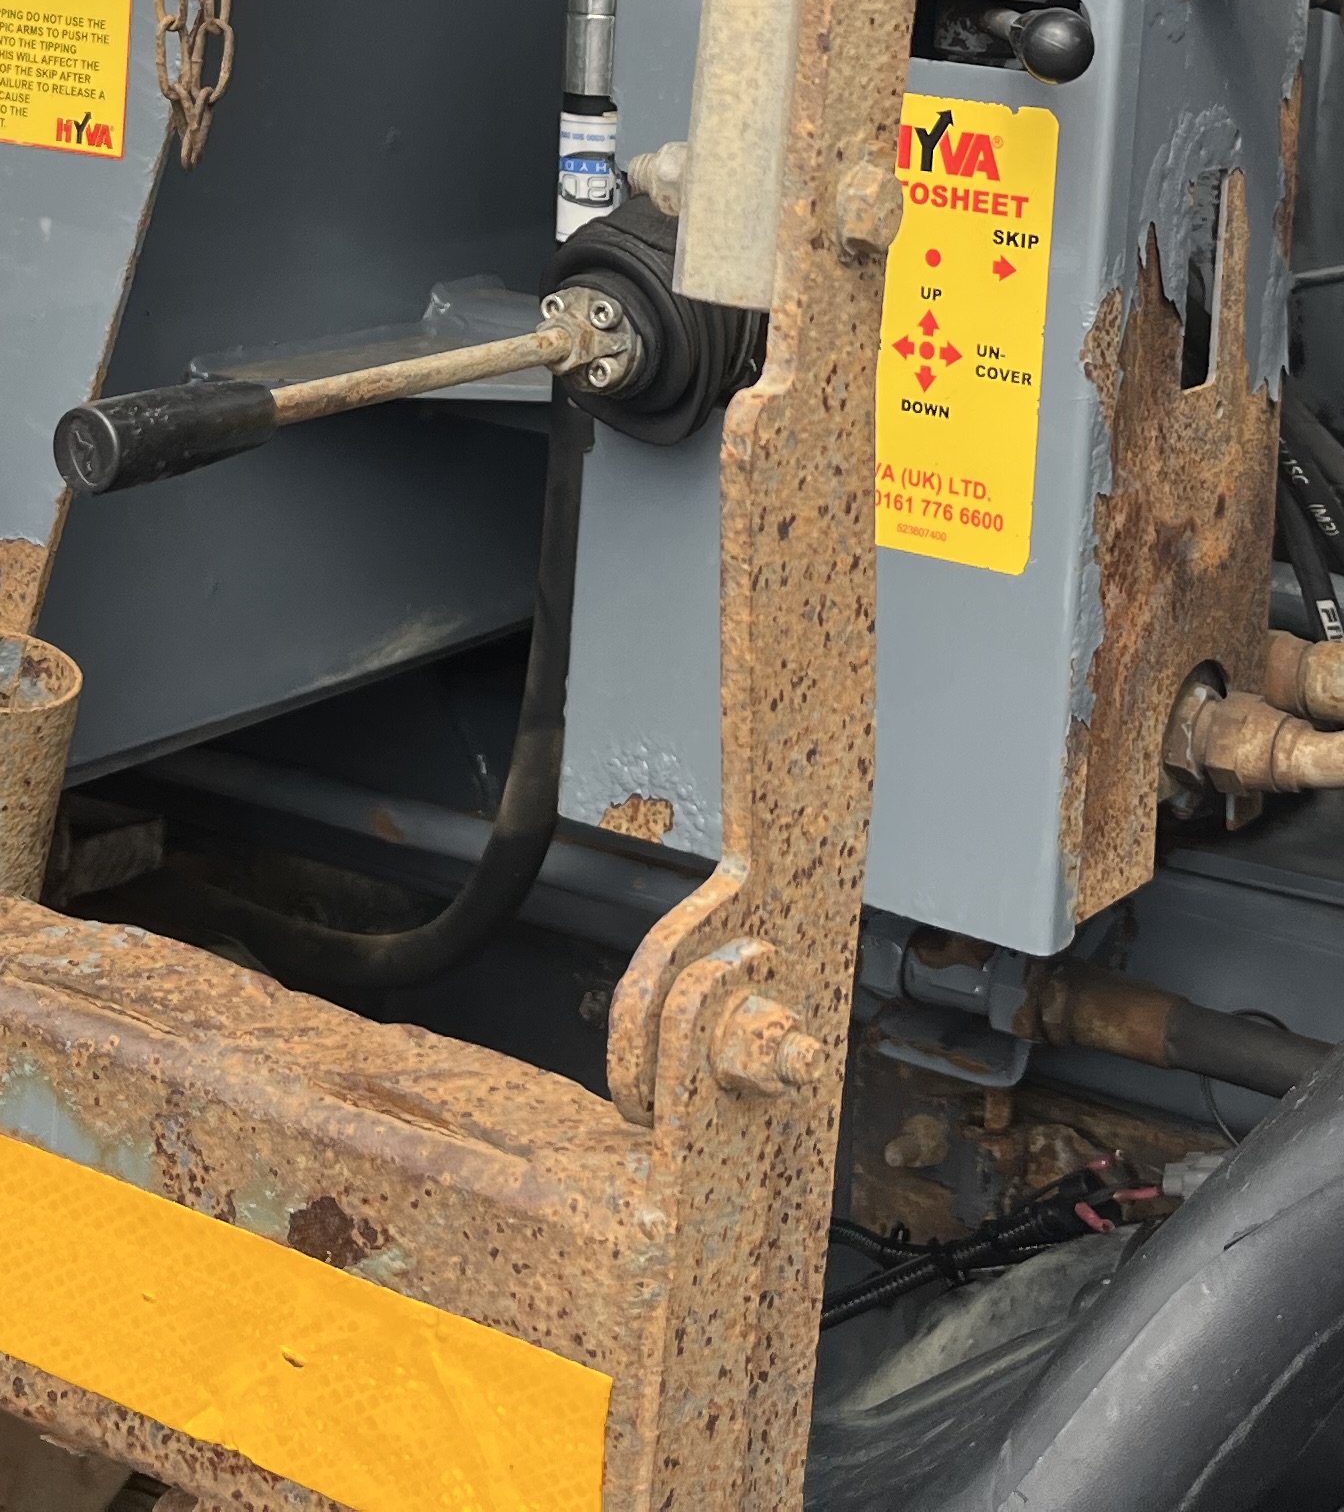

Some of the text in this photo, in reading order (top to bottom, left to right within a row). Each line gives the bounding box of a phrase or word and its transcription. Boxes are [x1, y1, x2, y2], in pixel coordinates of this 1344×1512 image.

[26, 12, 40, 22] DO
[43, 14, 63, 25] NOT
[66, 16, 84, 28] USE
[88, 18, 106, 30] THE
[16, 24, 44, 37] ARMS
[46, 28, 60, 38] TO
[62, 30, 88, 41] PUSH
[91, 33, 110, 45] THE
[18, 38, 37, 50] THE
[40, 40, 77, 55] TIPPING
[17, 52, 39, 64] WILL
[41, 55, 79, 69] AFFECT
[81, 60, 100, 72] THE
[0, 64, 12, 74] OF
[15, 66, 33, 77] THE
[36, 68, 58, 80] SKIP
[60, 71, 91, 84] AFTER
[36, 82, 50, 93] TO
[52, 84, 96, 99] RELEASE
[98, 90, 106, 101] A
[10, 106, 29, 117] THE
[56, 112, 113, 149] HYVA
[902, 181, 1029, 219] OSHEET
[992, 230, 1039, 249] SKIP
[921, 286, 942, 301] UP
[976, 344, 1005, 360] UN-
[976, 365, 1032, 386] COVER
[902, 399, 950, 419] DOWN
[902, 468, 942, 496] (UK)
[949, 477, 991, 502] LTD.
[921, 499, 953, 521] 776
[960, 507, 1004, 532] 6600
